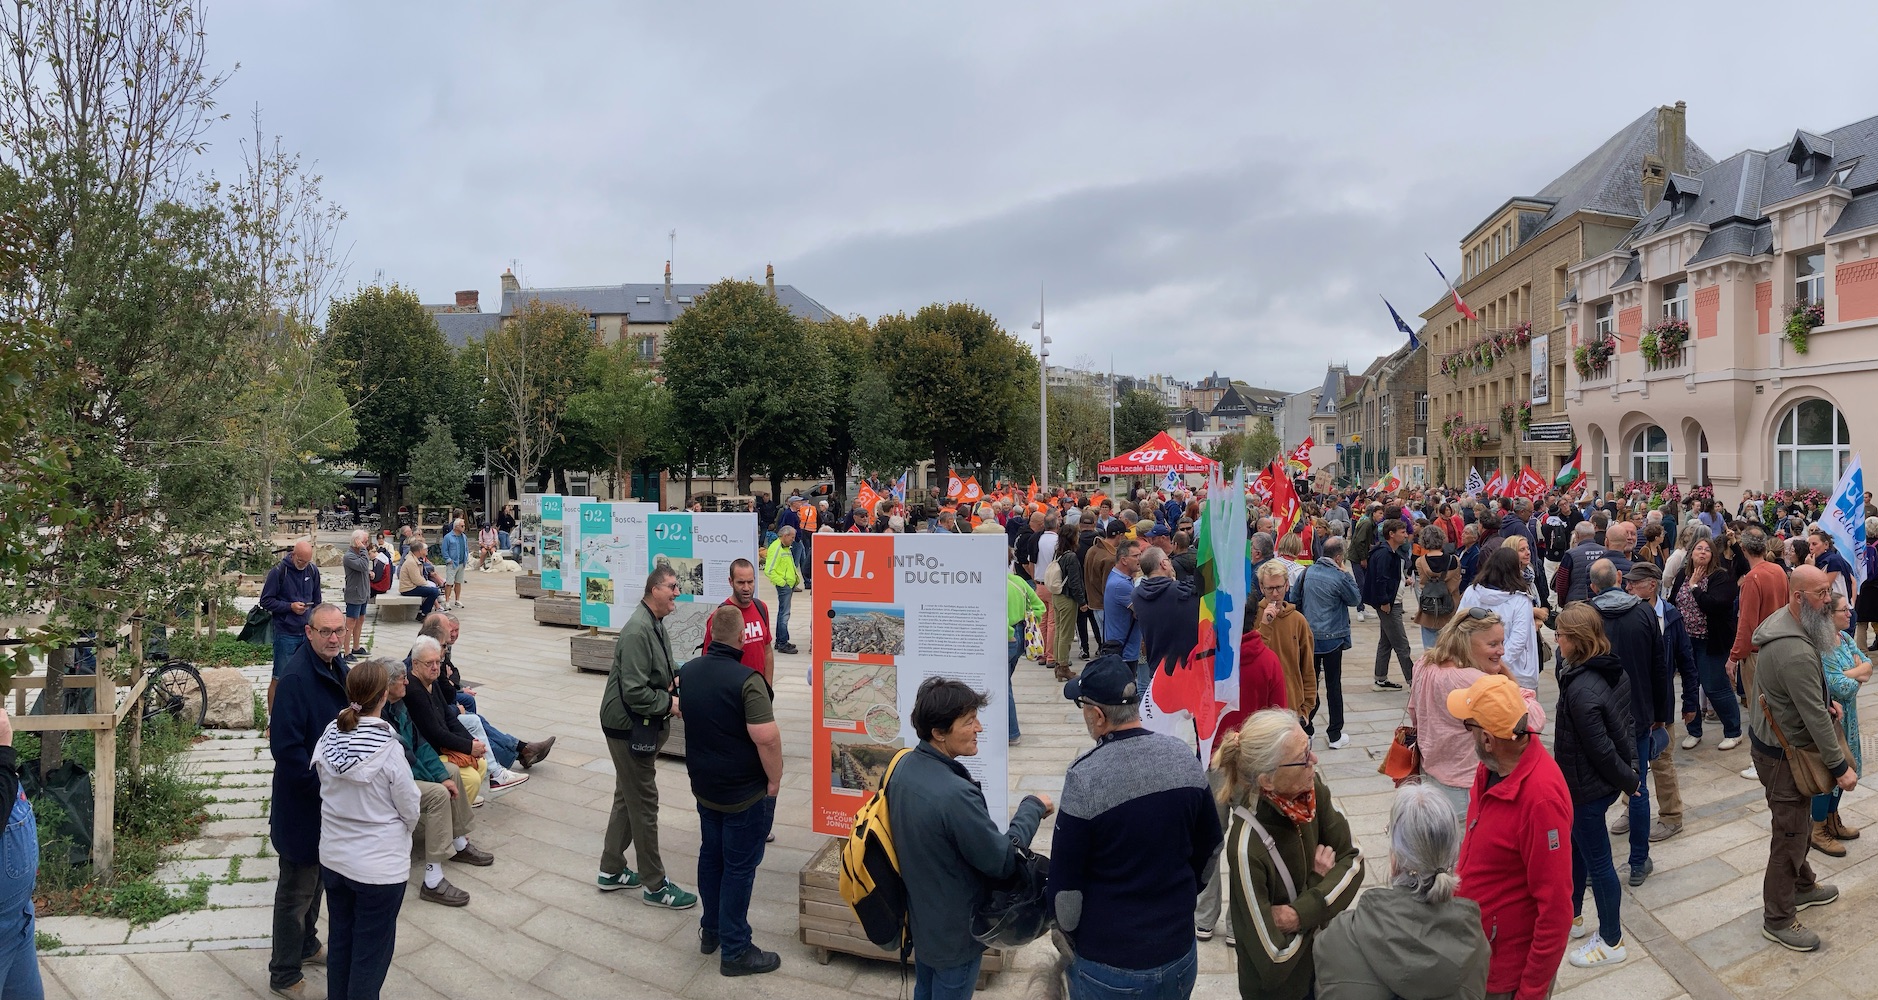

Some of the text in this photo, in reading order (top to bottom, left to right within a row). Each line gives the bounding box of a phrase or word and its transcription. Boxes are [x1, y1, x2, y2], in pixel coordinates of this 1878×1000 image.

[1128, 448, 1168, 463] cgt
[1100, 464, 1119, 472] Union
[1121, 464, 1143, 472] Locale
[584, 509, 605, 522] 02.
[655, 522, 687, 541] 02.
[688, 526, 699, 534] LE
[697, 534, 729, 544] BOSCQ
[825, 549, 875, 580] 01.
[887, 553, 945, 569] INTRO-
[904, 570, 982, 585] DUCTION
[826, 821, 853, 830] JONVIL
